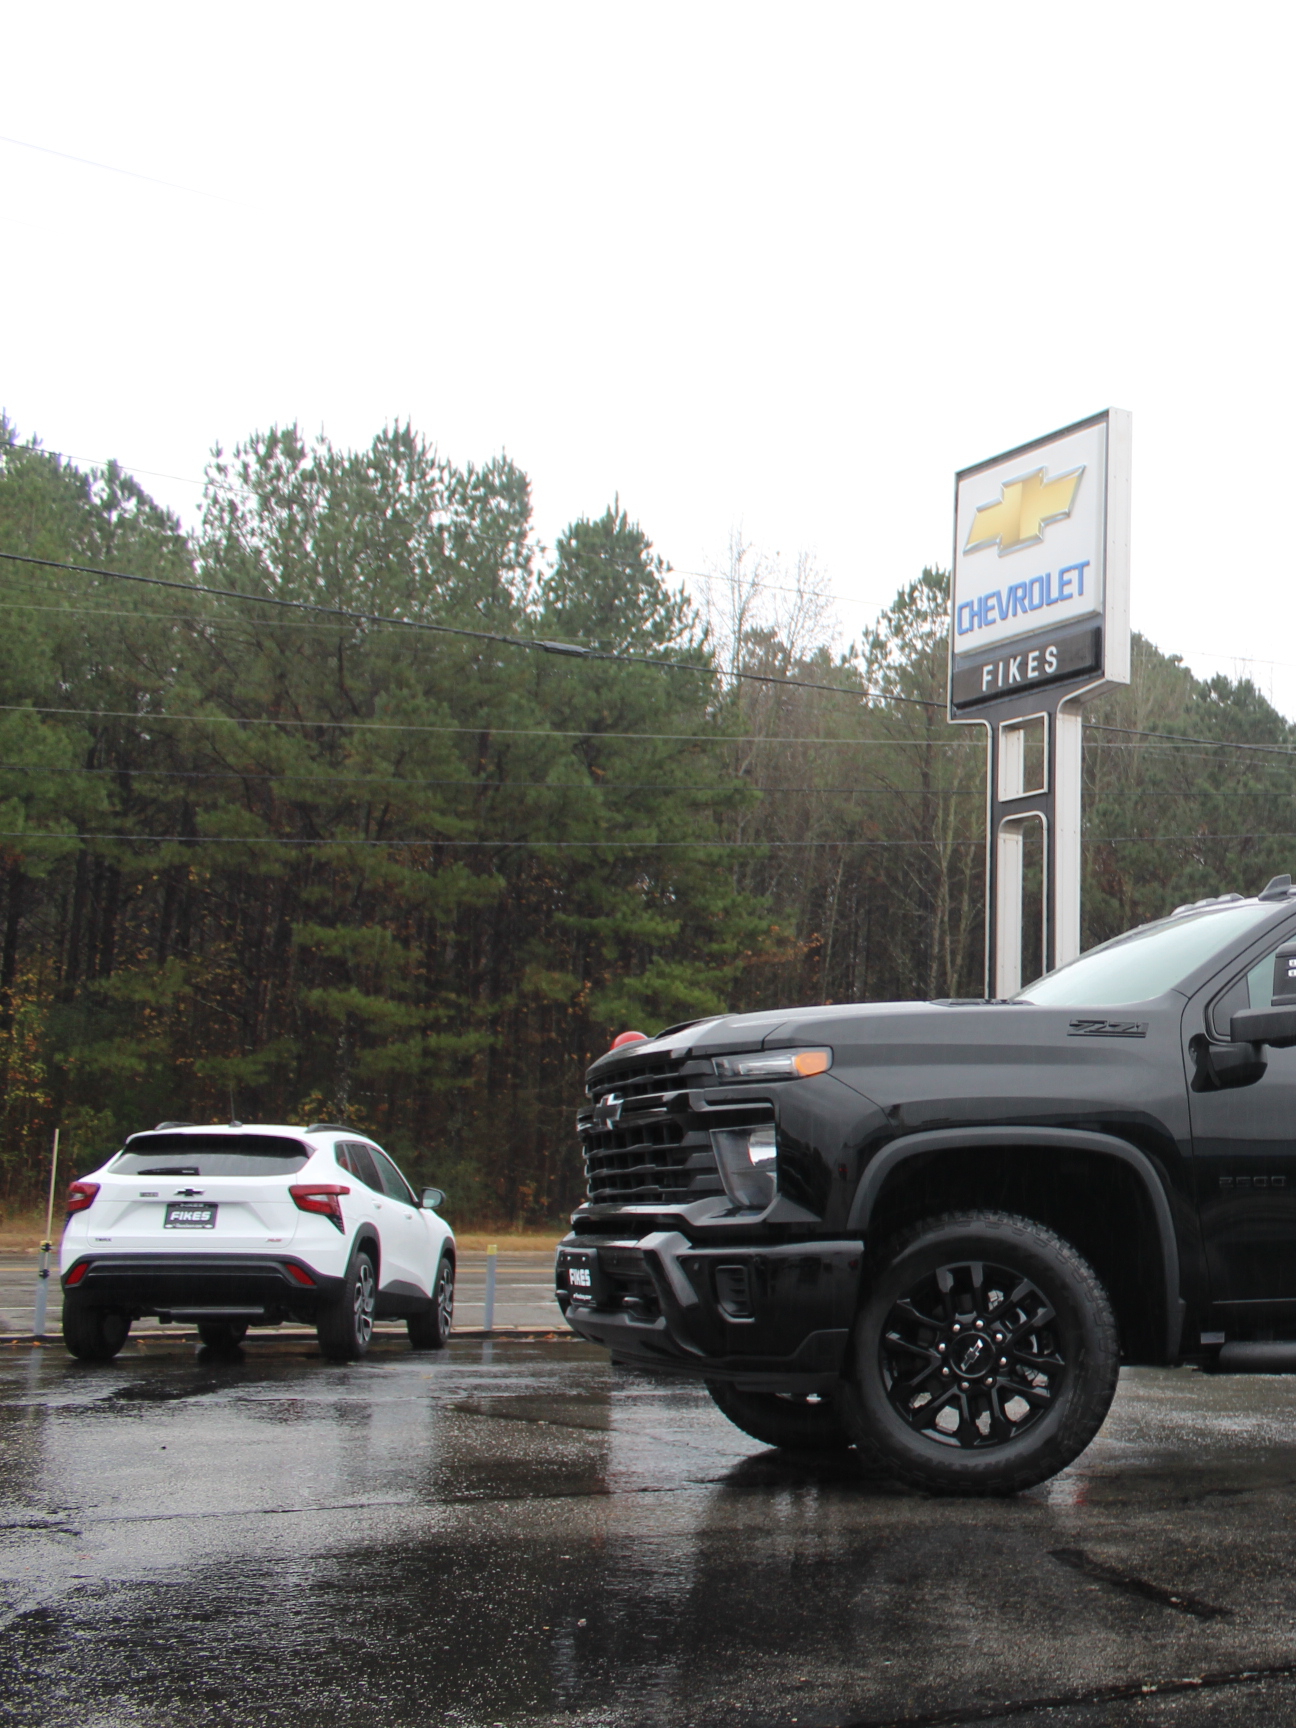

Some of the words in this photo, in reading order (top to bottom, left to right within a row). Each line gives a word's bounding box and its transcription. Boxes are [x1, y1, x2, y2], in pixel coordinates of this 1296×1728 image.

[956, 559, 1091, 636] CHEVROLET
[981, 645, 1059, 692] FIKES
[170, 1211, 212, 1221] FIKES
[569, 1268, 591, 1287] FIKES
